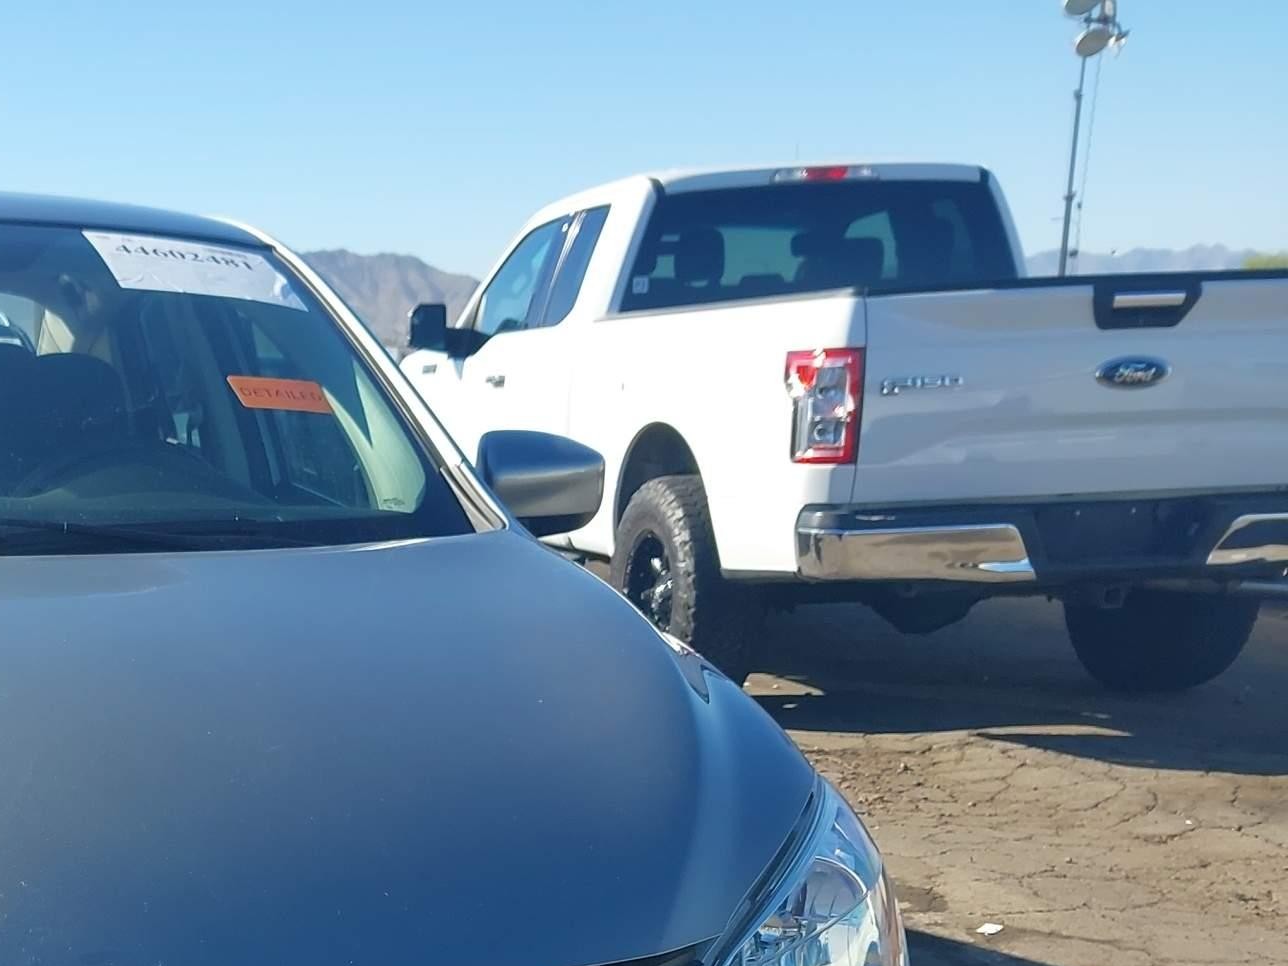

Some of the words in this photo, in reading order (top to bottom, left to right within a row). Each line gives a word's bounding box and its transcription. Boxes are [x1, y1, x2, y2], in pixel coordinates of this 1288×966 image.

[115, 244, 254, 271] 44602481
[1113, 363, 1157, 383] Ford
[239, 387, 323, 402] DETAILED
